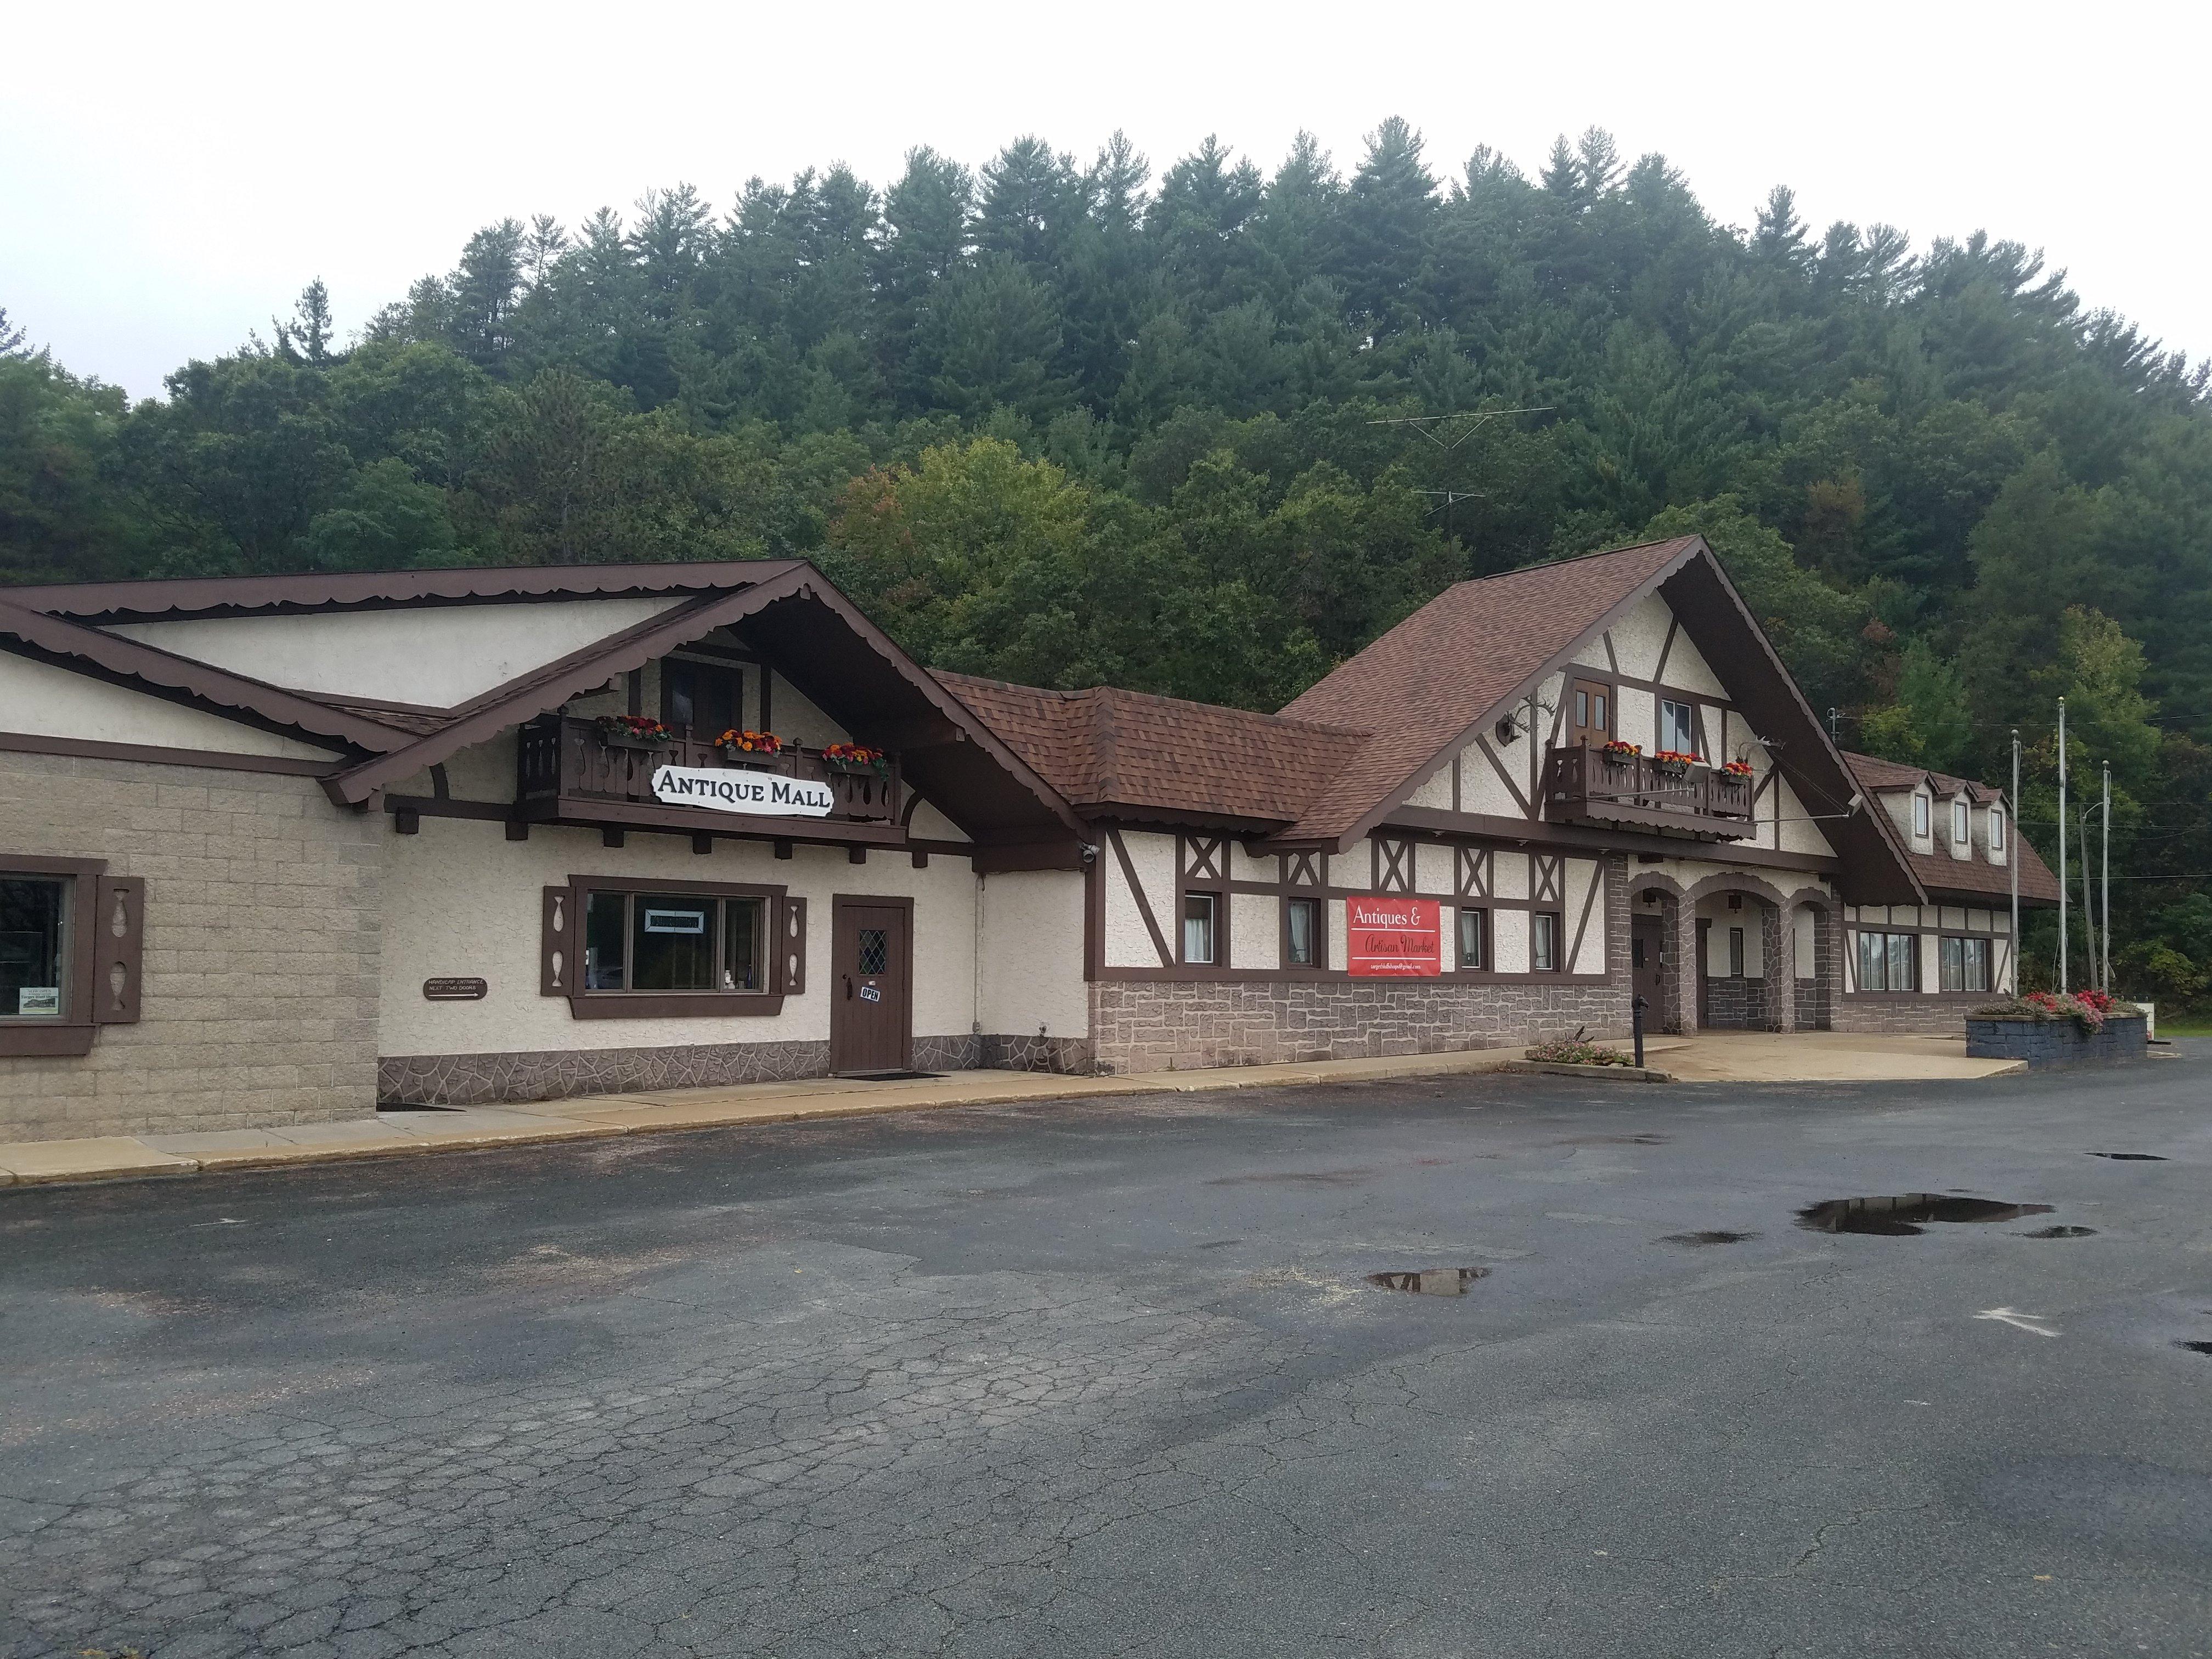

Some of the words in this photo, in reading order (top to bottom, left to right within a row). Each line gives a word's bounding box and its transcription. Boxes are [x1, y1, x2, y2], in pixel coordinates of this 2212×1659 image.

[658, 770, 764, 803] ANTIQUE
[771, 782, 831, 808] MALL
[1353, 905, 1407, 928] Antiques
[1410, 907, 1421, 926] &
[1365, 934, 1399, 952] Artisan
[1400, 935, 1434, 953] Market
[862, 988, 878, 1000] OPEN
